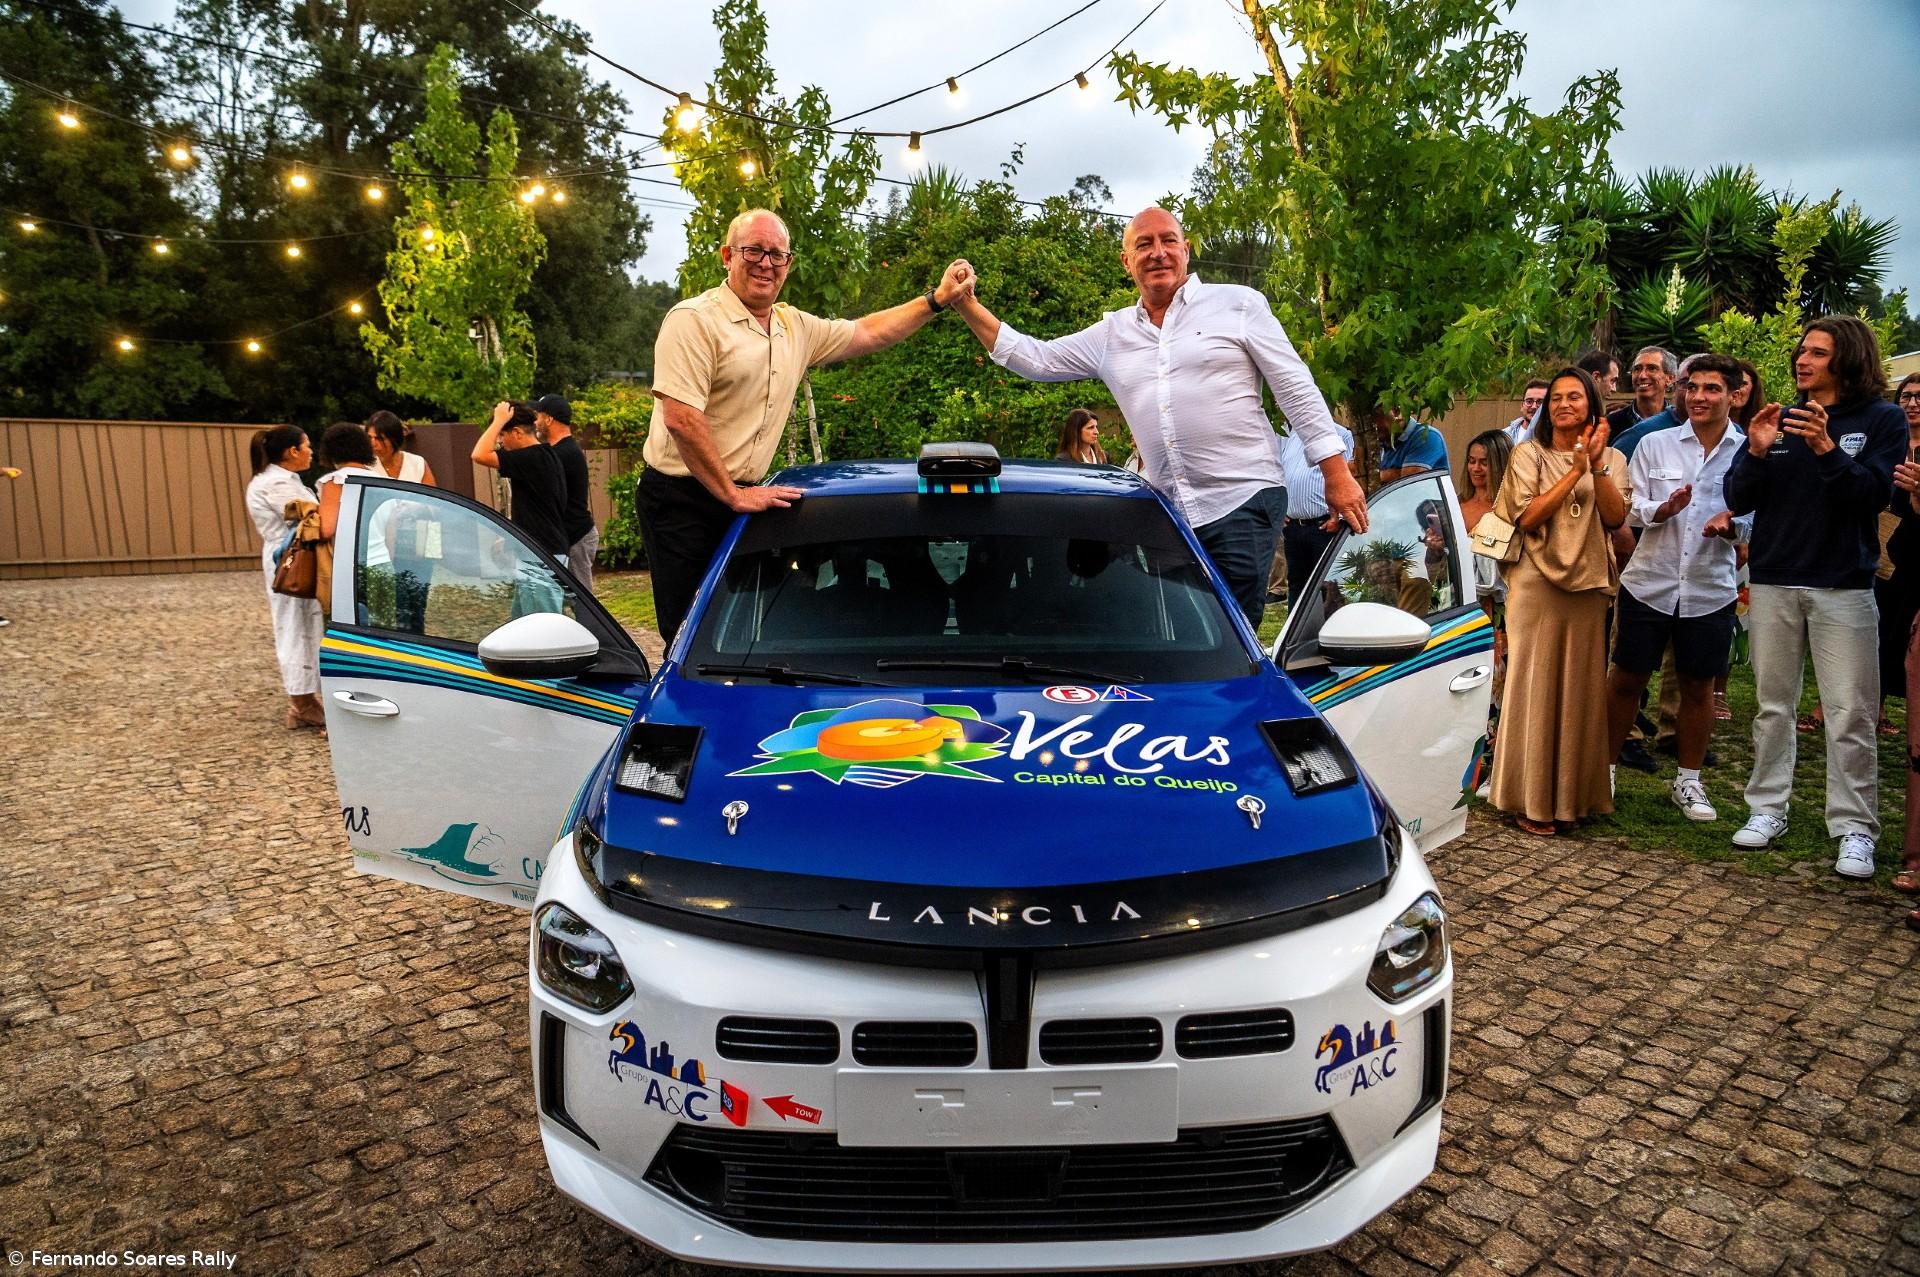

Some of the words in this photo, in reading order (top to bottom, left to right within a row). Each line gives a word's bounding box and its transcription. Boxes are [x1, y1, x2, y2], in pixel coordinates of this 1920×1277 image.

[1059, 689, 1082, 700] E
[1009, 710, 1231, 774] Velas
[1013, 771, 1106, 786] Capital
[1113, 774, 1147, 787] do
[1153, 775, 1239, 794] Queijo
[342, 806, 371, 836] as
[868, 901, 1142, 926] LANCIA
[620, 1064, 649, 1083] Grupo
[1350, 1047, 1398, 1097] A&C
[643, 1078, 709, 1122] A&C
[795, 1107, 814, 1118] TOW
